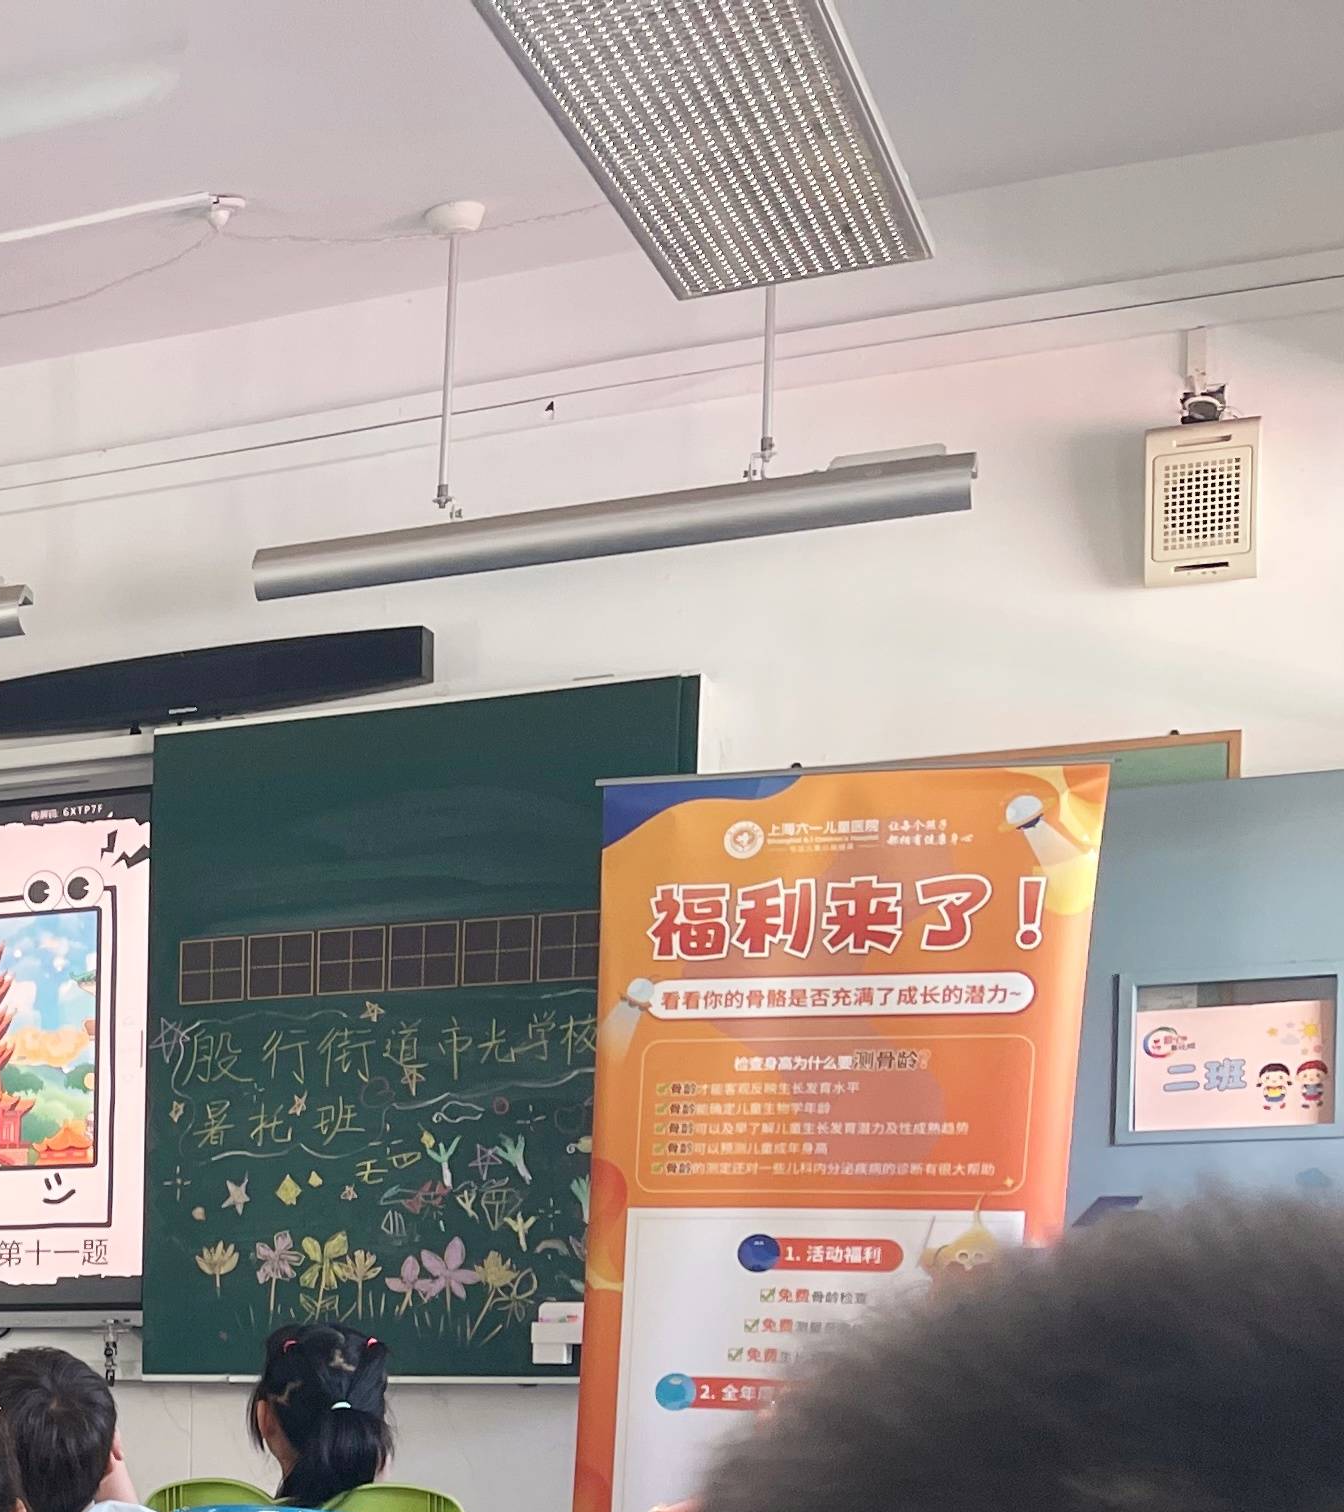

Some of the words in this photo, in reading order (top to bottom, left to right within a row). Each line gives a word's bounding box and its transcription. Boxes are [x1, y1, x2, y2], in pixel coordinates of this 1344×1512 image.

[1163, 1057, 1247, 1092] 二班
[193, 1096, 365, 1147] 暑托班
[806, 1245, 882, 1264] 活动福利
